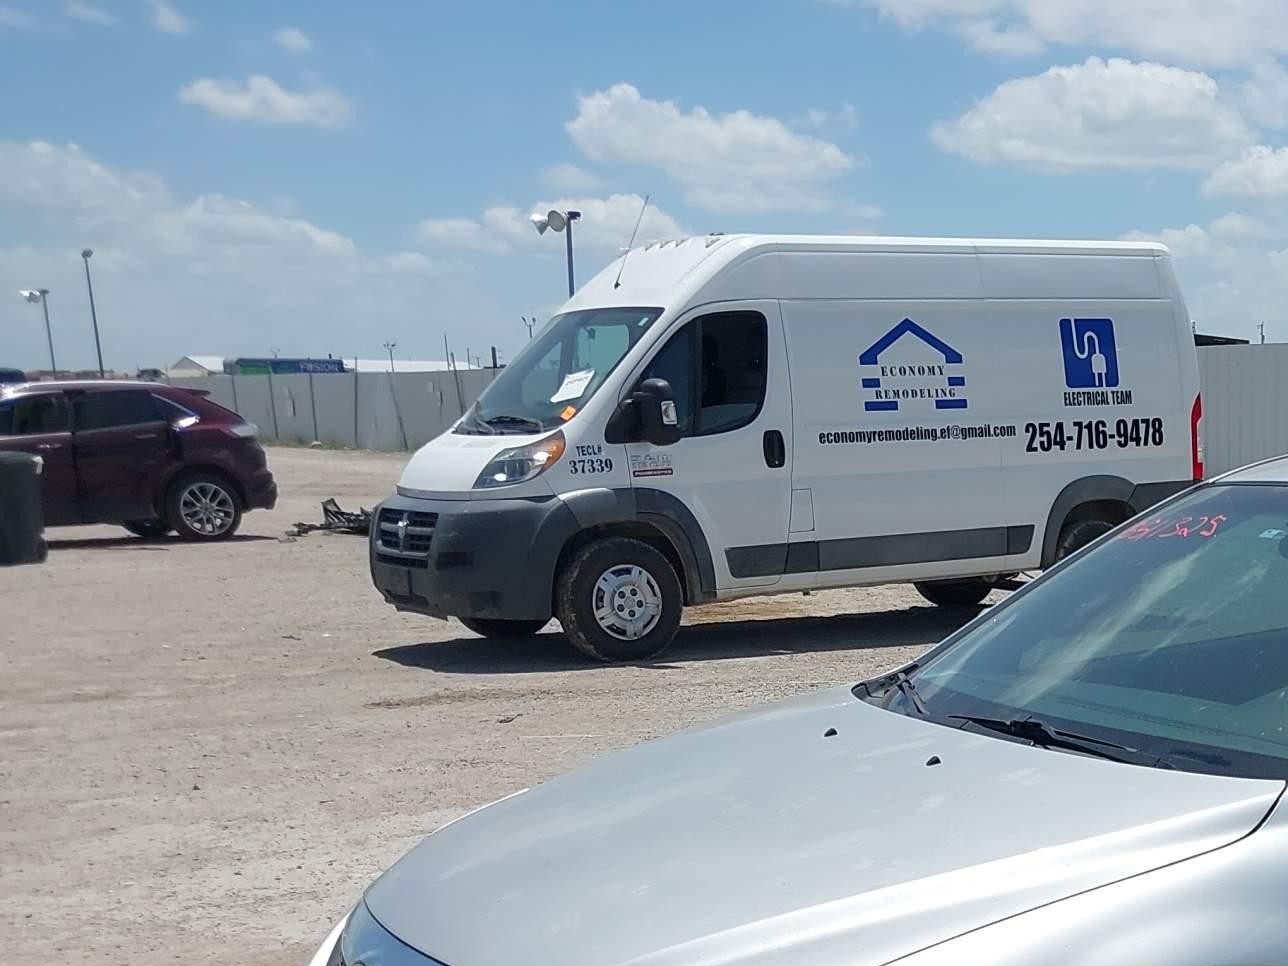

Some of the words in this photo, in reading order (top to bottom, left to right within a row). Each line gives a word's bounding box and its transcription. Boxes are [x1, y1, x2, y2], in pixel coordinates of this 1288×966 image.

[880, 365, 946, 377] ECONOMY
[874, 387, 957, 400] REMODELING
[1063, 391, 1110, 407] ELECTRICAL
[1110, 390, 1133, 405] TEAM
[818, 424, 1017, 445] economyremodeling.ef@gmail.com
[1024, 417, 1164, 453] 254-716-9478
[575, 445, 603, 457] TECL#
[568, 458, 614, 475] 37339
